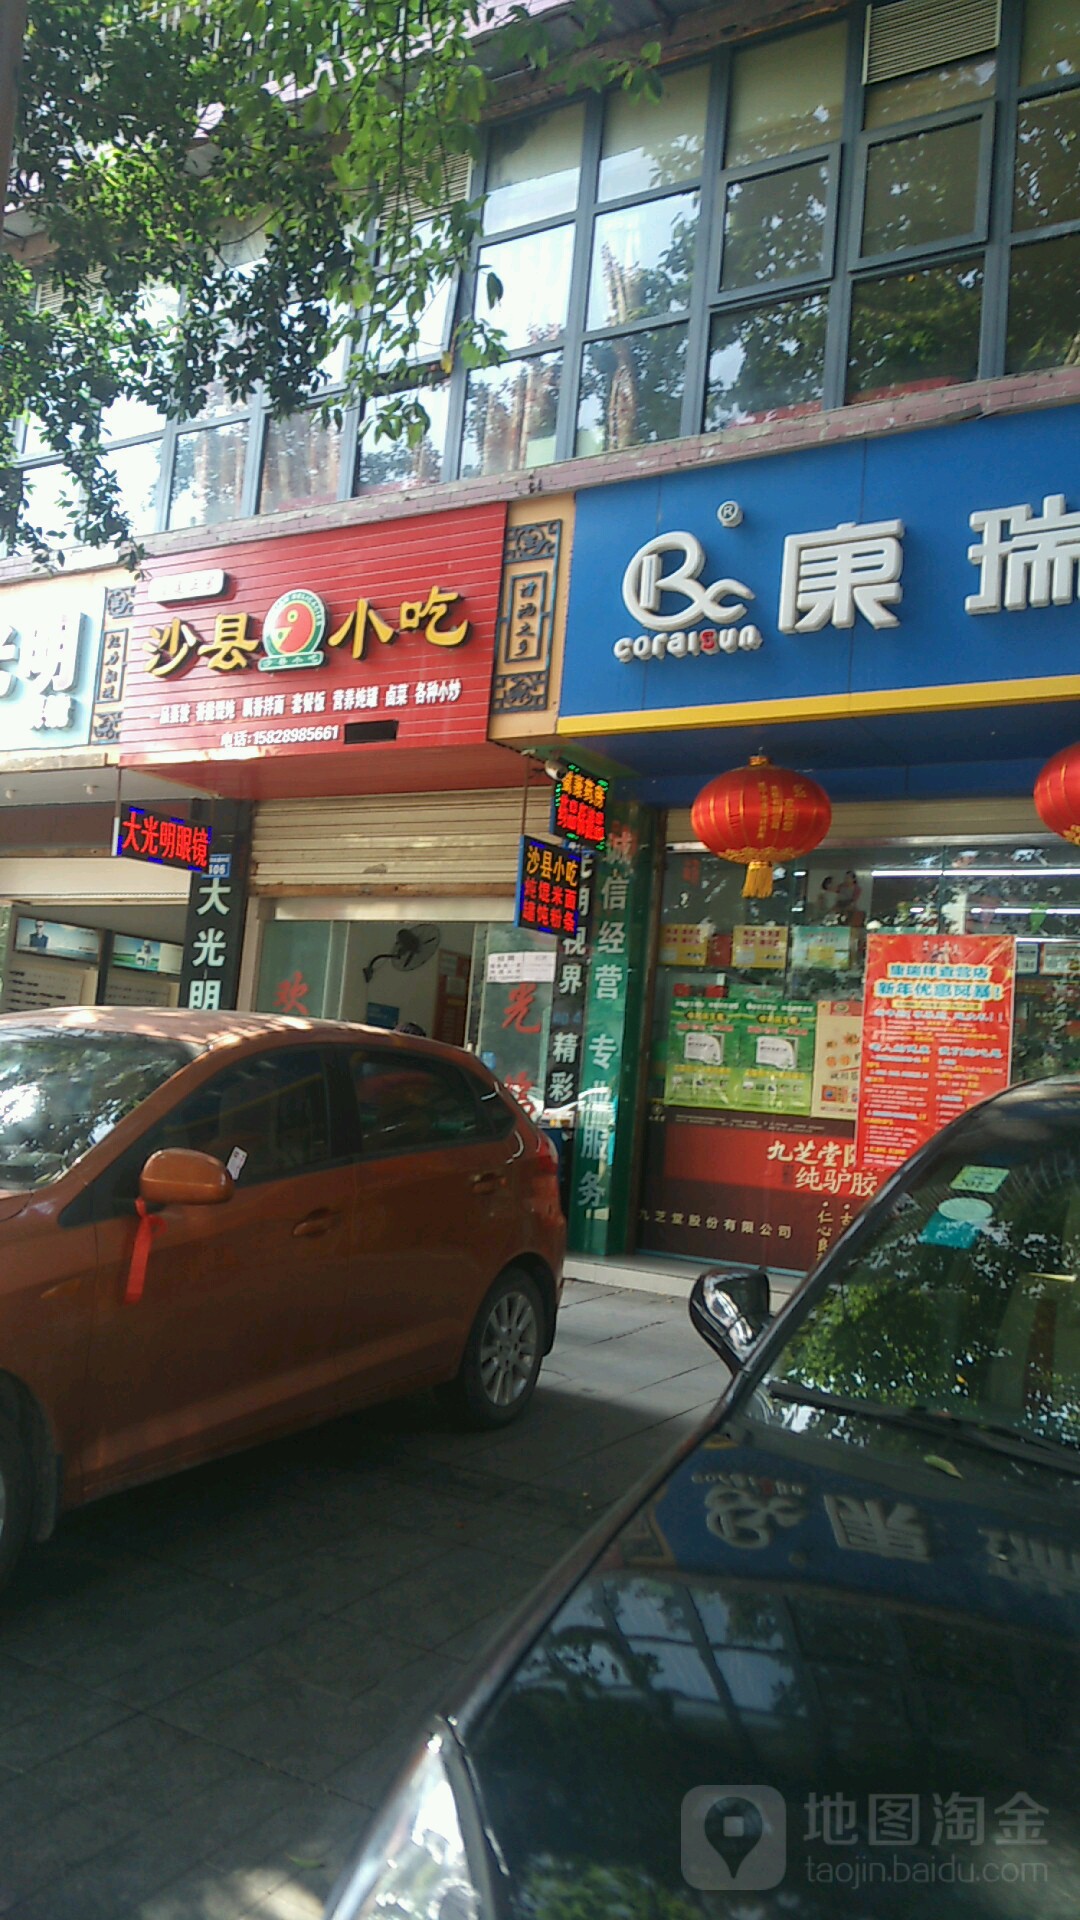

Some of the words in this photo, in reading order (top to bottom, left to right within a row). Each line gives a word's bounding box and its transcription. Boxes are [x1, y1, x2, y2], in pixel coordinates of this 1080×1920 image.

[121, 810, 208, 868] 大光明眼镜
[525, 845, 578, 887] 沙县小吃
[188, 877, 232, 1010] 大光明
[795, 1165, 878, 1197] 纯驴胶
